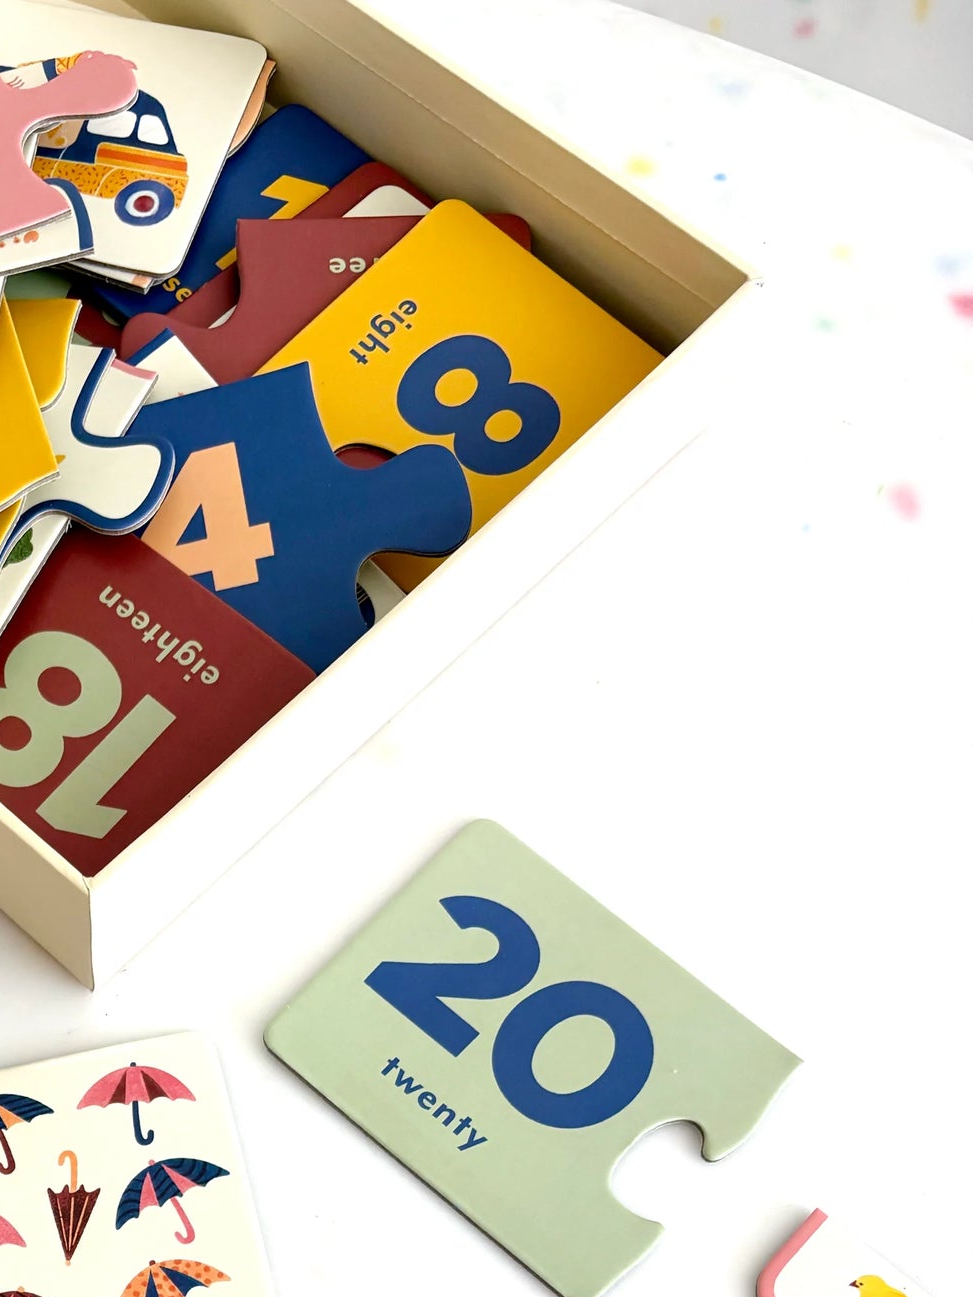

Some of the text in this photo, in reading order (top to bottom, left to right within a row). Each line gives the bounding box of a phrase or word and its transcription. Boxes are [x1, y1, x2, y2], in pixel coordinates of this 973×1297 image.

[349, 299, 418, 365] eight
[397, 335, 561, 476] 8
[140, 442, 275, 592] 4
[98, 584, 220, 685] eighteen
[363, 895, 654, 1129] 20
[381, 1056, 488, 1151] twenty
